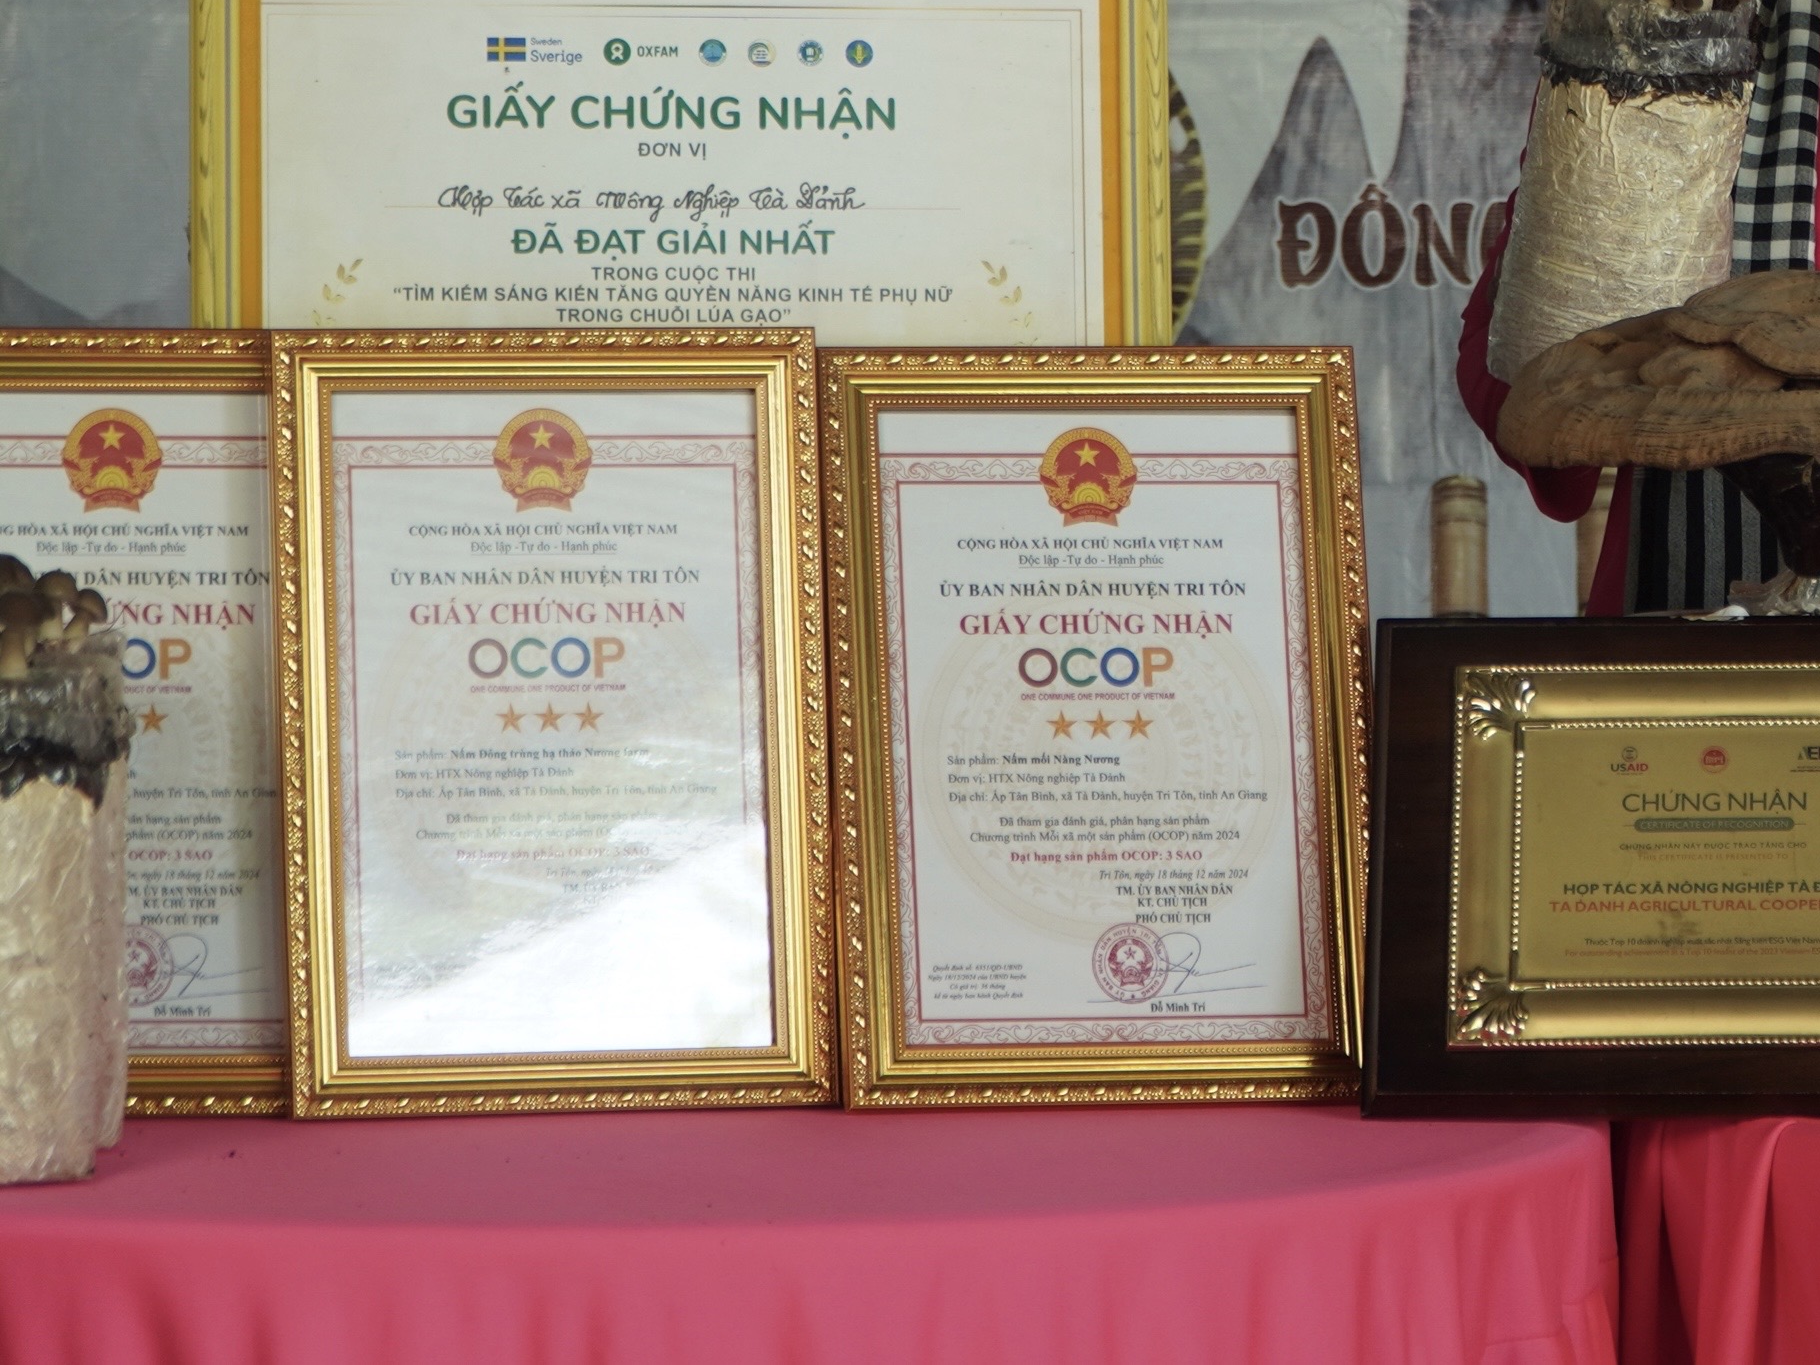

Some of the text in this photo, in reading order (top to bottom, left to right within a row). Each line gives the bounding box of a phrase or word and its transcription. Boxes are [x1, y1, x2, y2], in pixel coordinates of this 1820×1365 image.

[530, 37, 563, 46] Sweden
[530, 46, 679, 66] Sverige OXFAM
[446, 81, 895, 140] GIẤY CHỨNG NHẬN
[637, 142, 707, 161] ĐƠN VỊ
[511, 220, 836, 260] ĐÃ ĐẠT GIẢI NHẤT
[592, 266, 755, 284] TRONG CUỘC THI
[494, 284, 548, 302] SÁNG
[606, 284, 658, 301] TĂNG
[738, 285, 791, 302] NĂNG
[799, 288, 842, 302] KINH
[880, 288, 917, 305] PHỤ
[556, 308, 623, 322] TRONG
[697, 305, 734, 322] LÚA
[969, 584, 1004, 597] BAN
[1010, 580, 1060, 597] NHÂN
[1066, 580, 1102, 596] DÂN
[1108, 581, 1170, 599] HUYỆN
[1174, 583, 1205, 596] TRI
[1209, 579, 1246, 596] TÔN
[172, 601, 256, 630] NHẬN
[410, 597, 686, 628] GIẤY CHỨNG NHẬN
[960, 608, 1233, 639] GIẤY CHỨNG NHẬN
[468, 637, 626, 679] OCOP
[1018, 647, 1173, 688] OCOP
[1610, 762, 1649, 772] USAID
[1622, 788, 1807, 814] CHỨNG NHẬN
[1603, 881, 1637, 894] TÁC
[1640, 881, 1664, 894] XÃ
[1668, 880, 1718, 894] NÔNG
[1722, 880, 1784, 895] NGHIỆP
[1788, 879, 1811, 893] TÀ
[1549, 901, 1573, 913] TA
[1628, 899, 1756, 912] AGRICULTURAL
